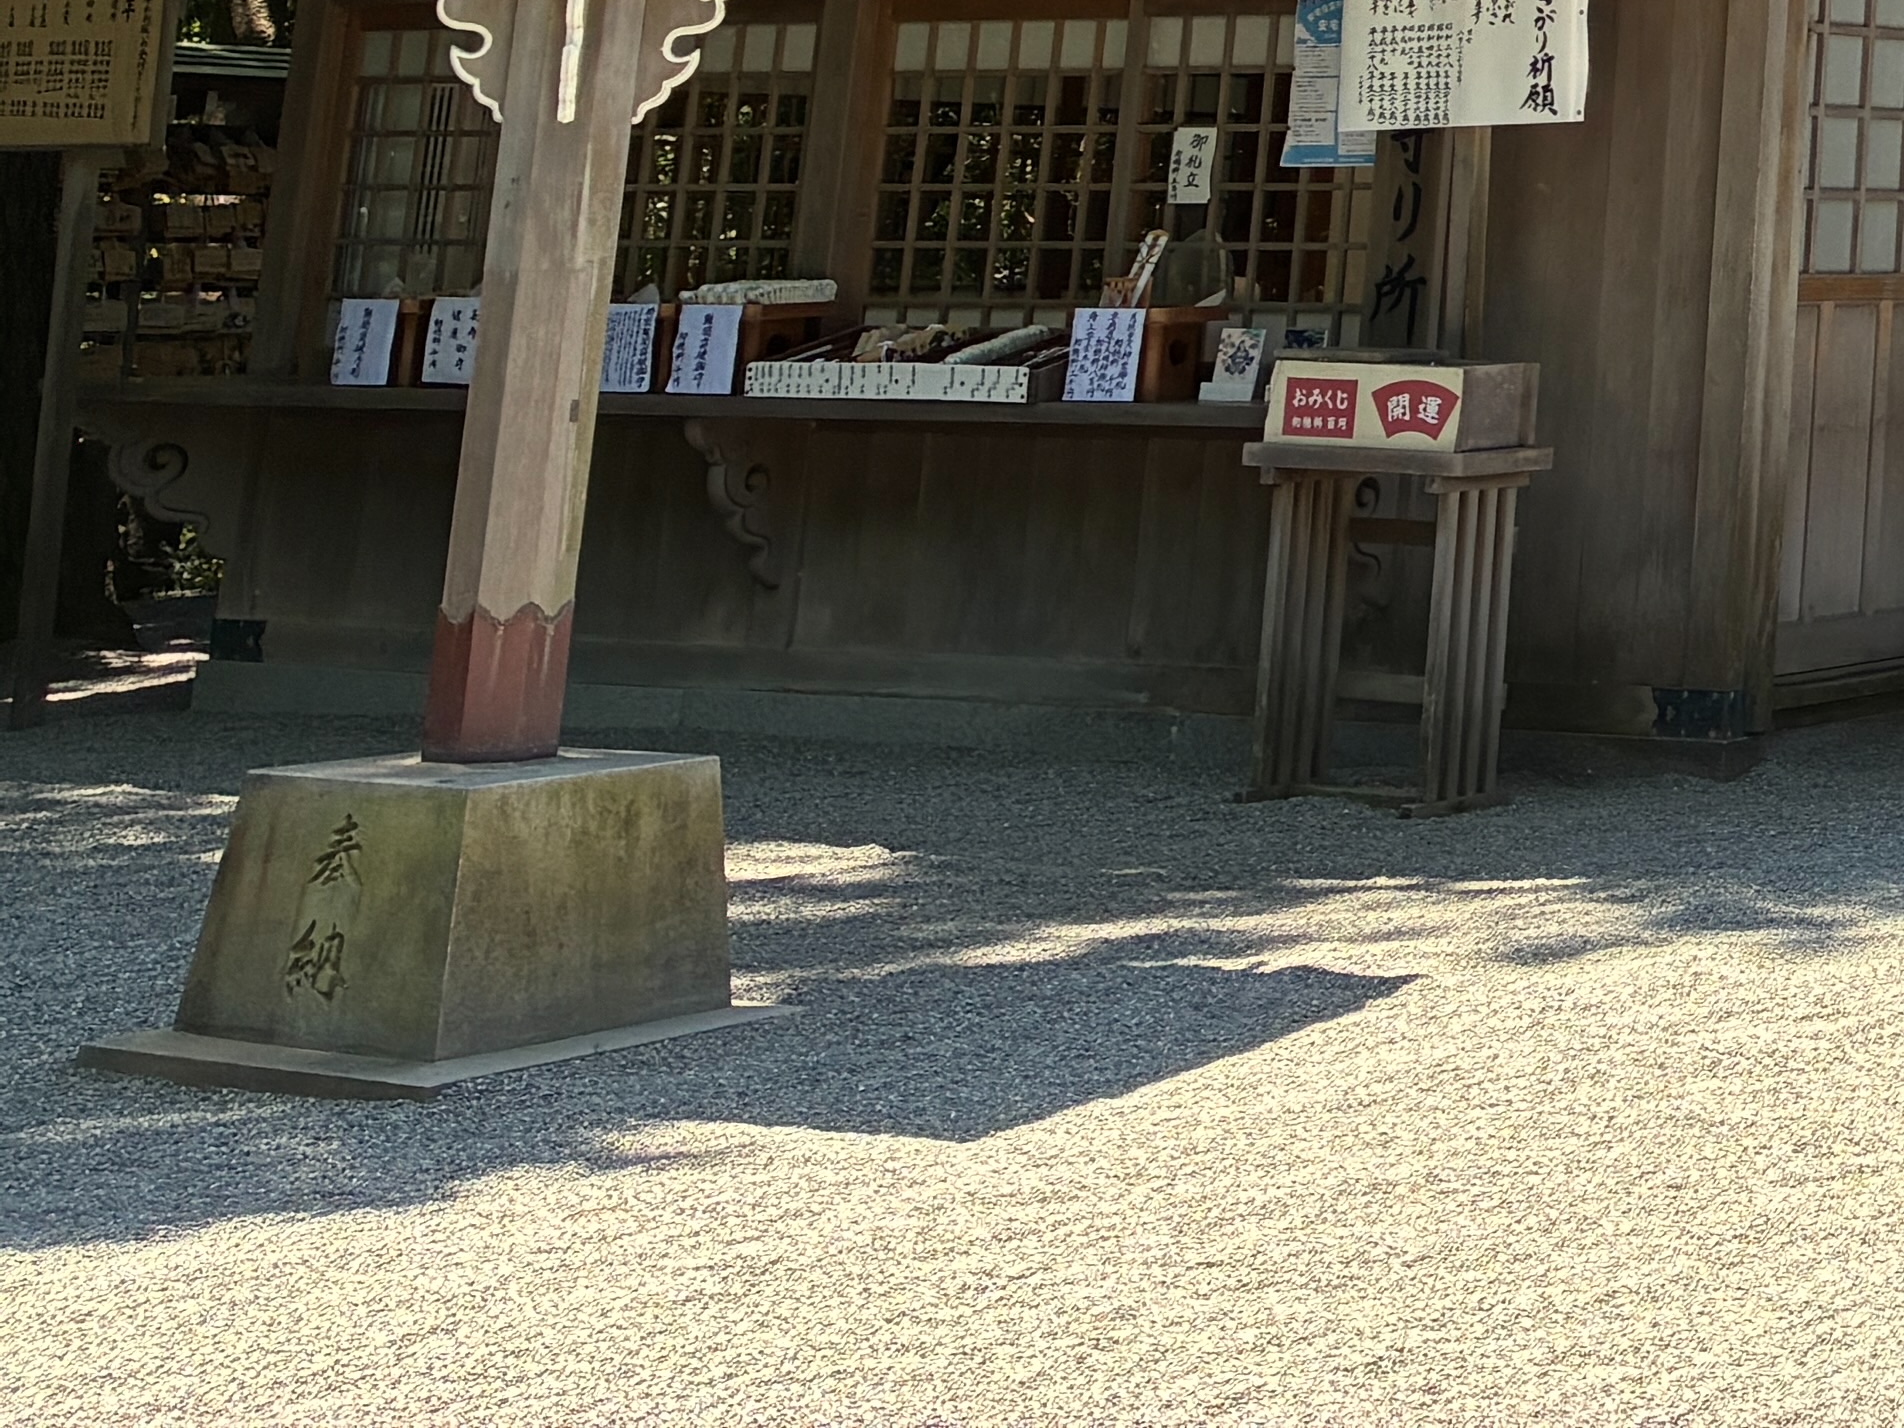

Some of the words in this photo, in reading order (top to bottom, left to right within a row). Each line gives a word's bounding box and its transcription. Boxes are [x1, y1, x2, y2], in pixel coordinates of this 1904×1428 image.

[1183, 133, 1209, 188] 御札立
[1292, 387, 1349, 410] おみくじ
[1387, 393, 1442, 425] 開運
[1292, 415, 1322, 429] 初穂料
[285, 812, 363, 1002] 奉納
